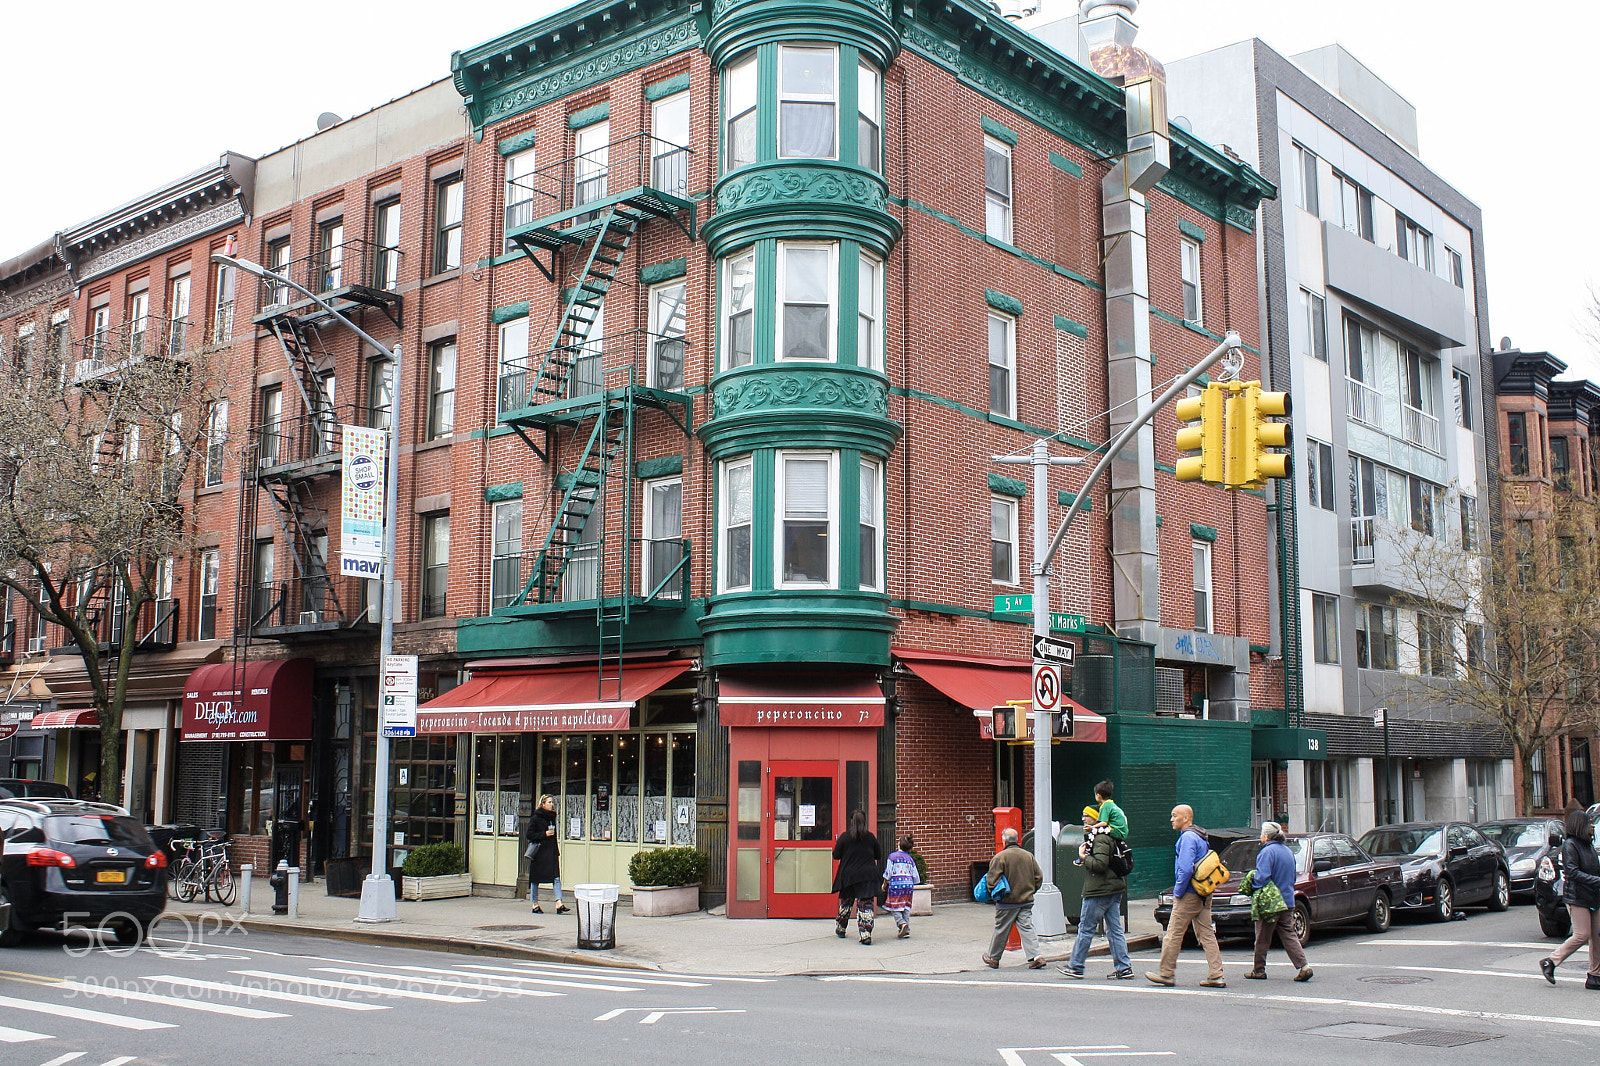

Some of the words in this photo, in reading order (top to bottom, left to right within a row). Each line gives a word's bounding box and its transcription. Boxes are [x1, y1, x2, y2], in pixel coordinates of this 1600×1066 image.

[355, 465, 372, 474] SHOP
[355, 471, 375, 480] SMALL
[1005, 597, 1011, 611] 5
[1014, 597, 1023, 606] Av
[1048, 615, 1055, 628] St
[1057, 615, 1078, 630] Marks
[1040, 642, 1052, 654] ONE
[1056, 648, 1070, 659] WAY
[186, 691, 199, 699] SALES
[251, 687, 269, 696] RENTALS
[386, 696, 393, 705] 2
[194, 701, 234, 720] DHCR
[757, 707, 843, 723] peperoncino
[858, 710, 870, 723] 72
[208, 709, 258, 730] expert.com
[420, 713, 468, 732] peperoncino
[523, 711, 559, 730] pizzeria
[561, 709, 613, 729] napoletana
[239, 730, 267, 738] CONSTRUCTION
[1307, 738, 1319, 751] 138
[400, 769, 407, 780] A
[679, 807, 687, 819] A
